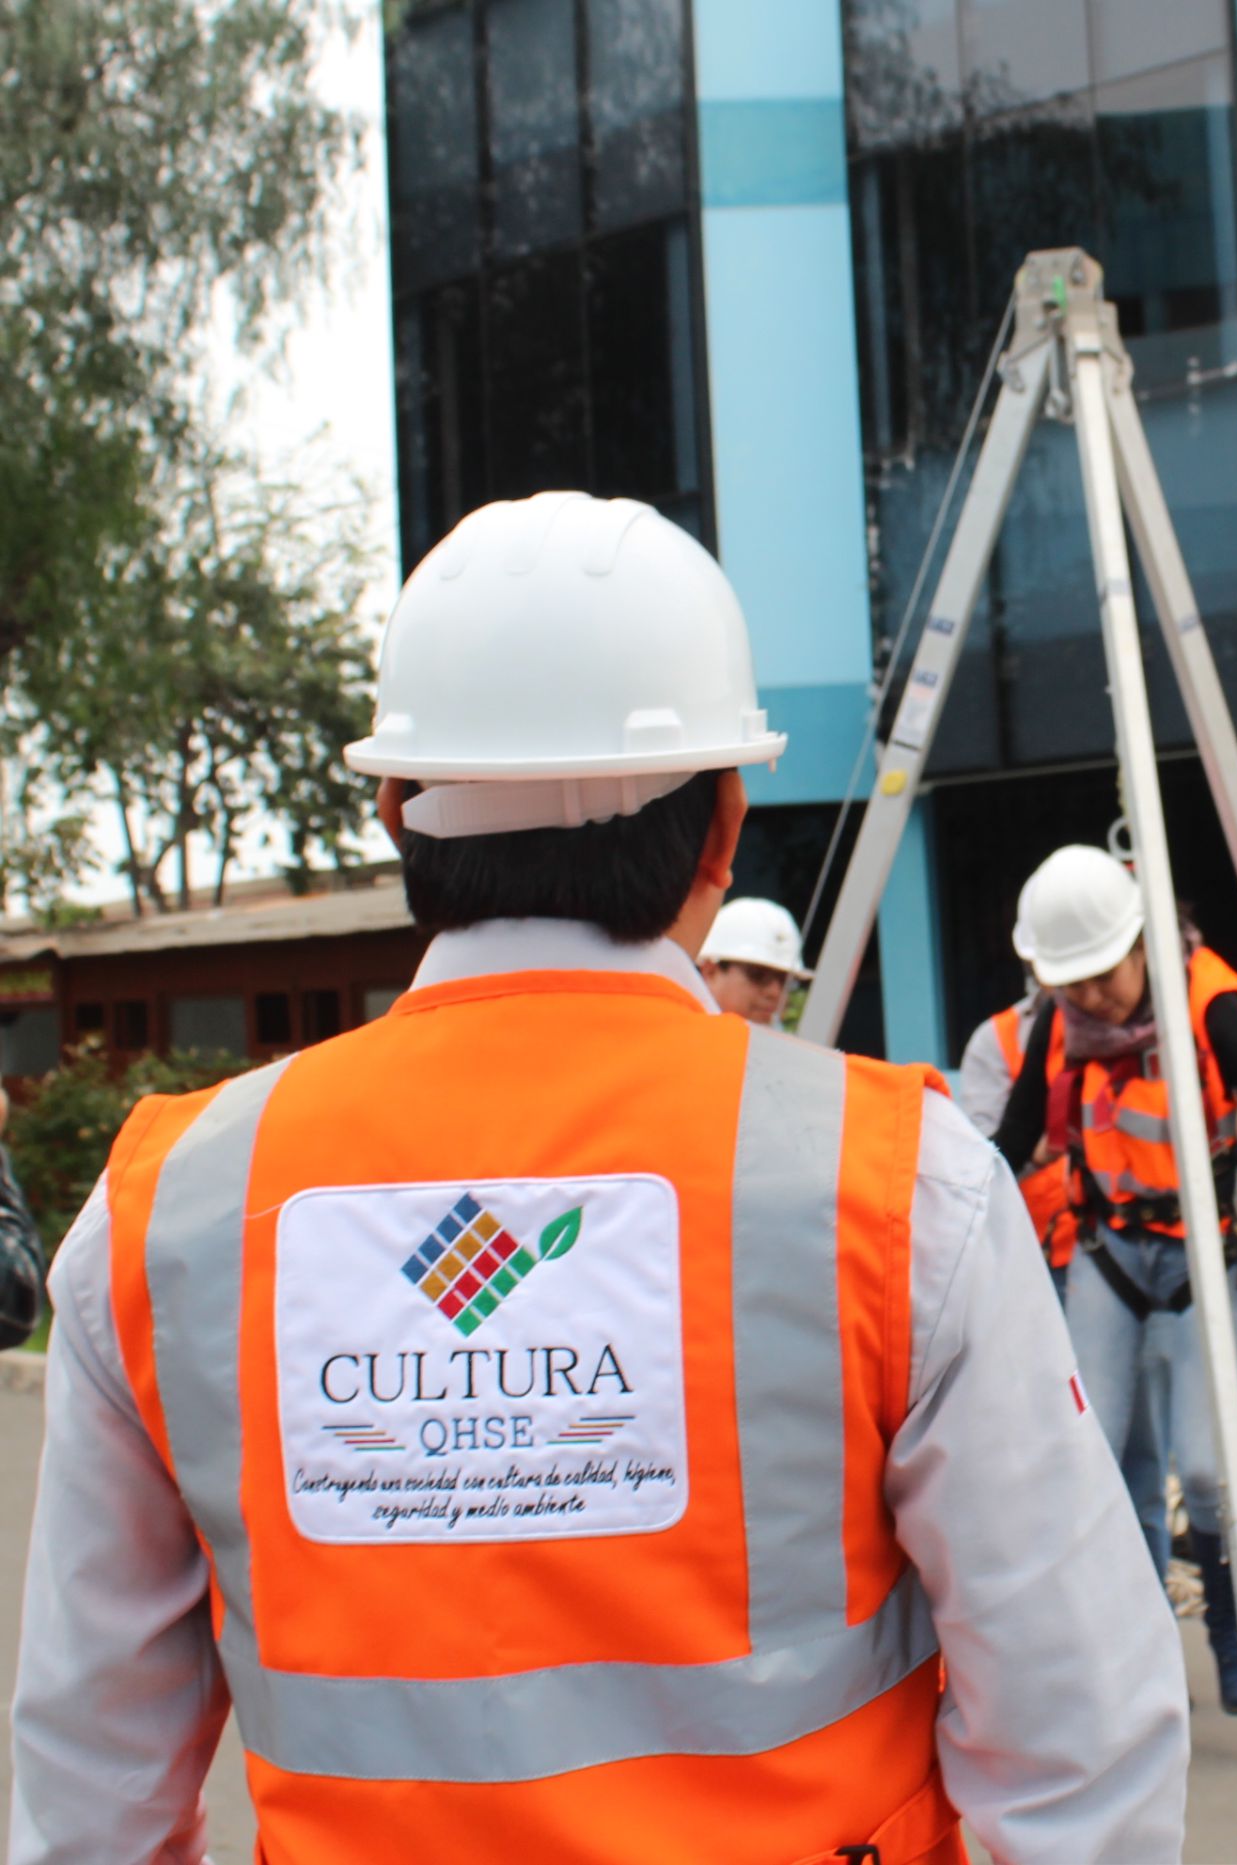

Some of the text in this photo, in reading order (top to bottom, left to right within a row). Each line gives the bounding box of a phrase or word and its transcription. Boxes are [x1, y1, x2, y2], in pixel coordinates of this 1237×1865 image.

[321, 1343, 634, 1404] CULTURA
[420, 1415, 534, 1457] QHSE
[544, 1463, 561, 1486] de
[465, 1496, 508, 1519] medio
[512, 1492, 586, 1518] ambiente
